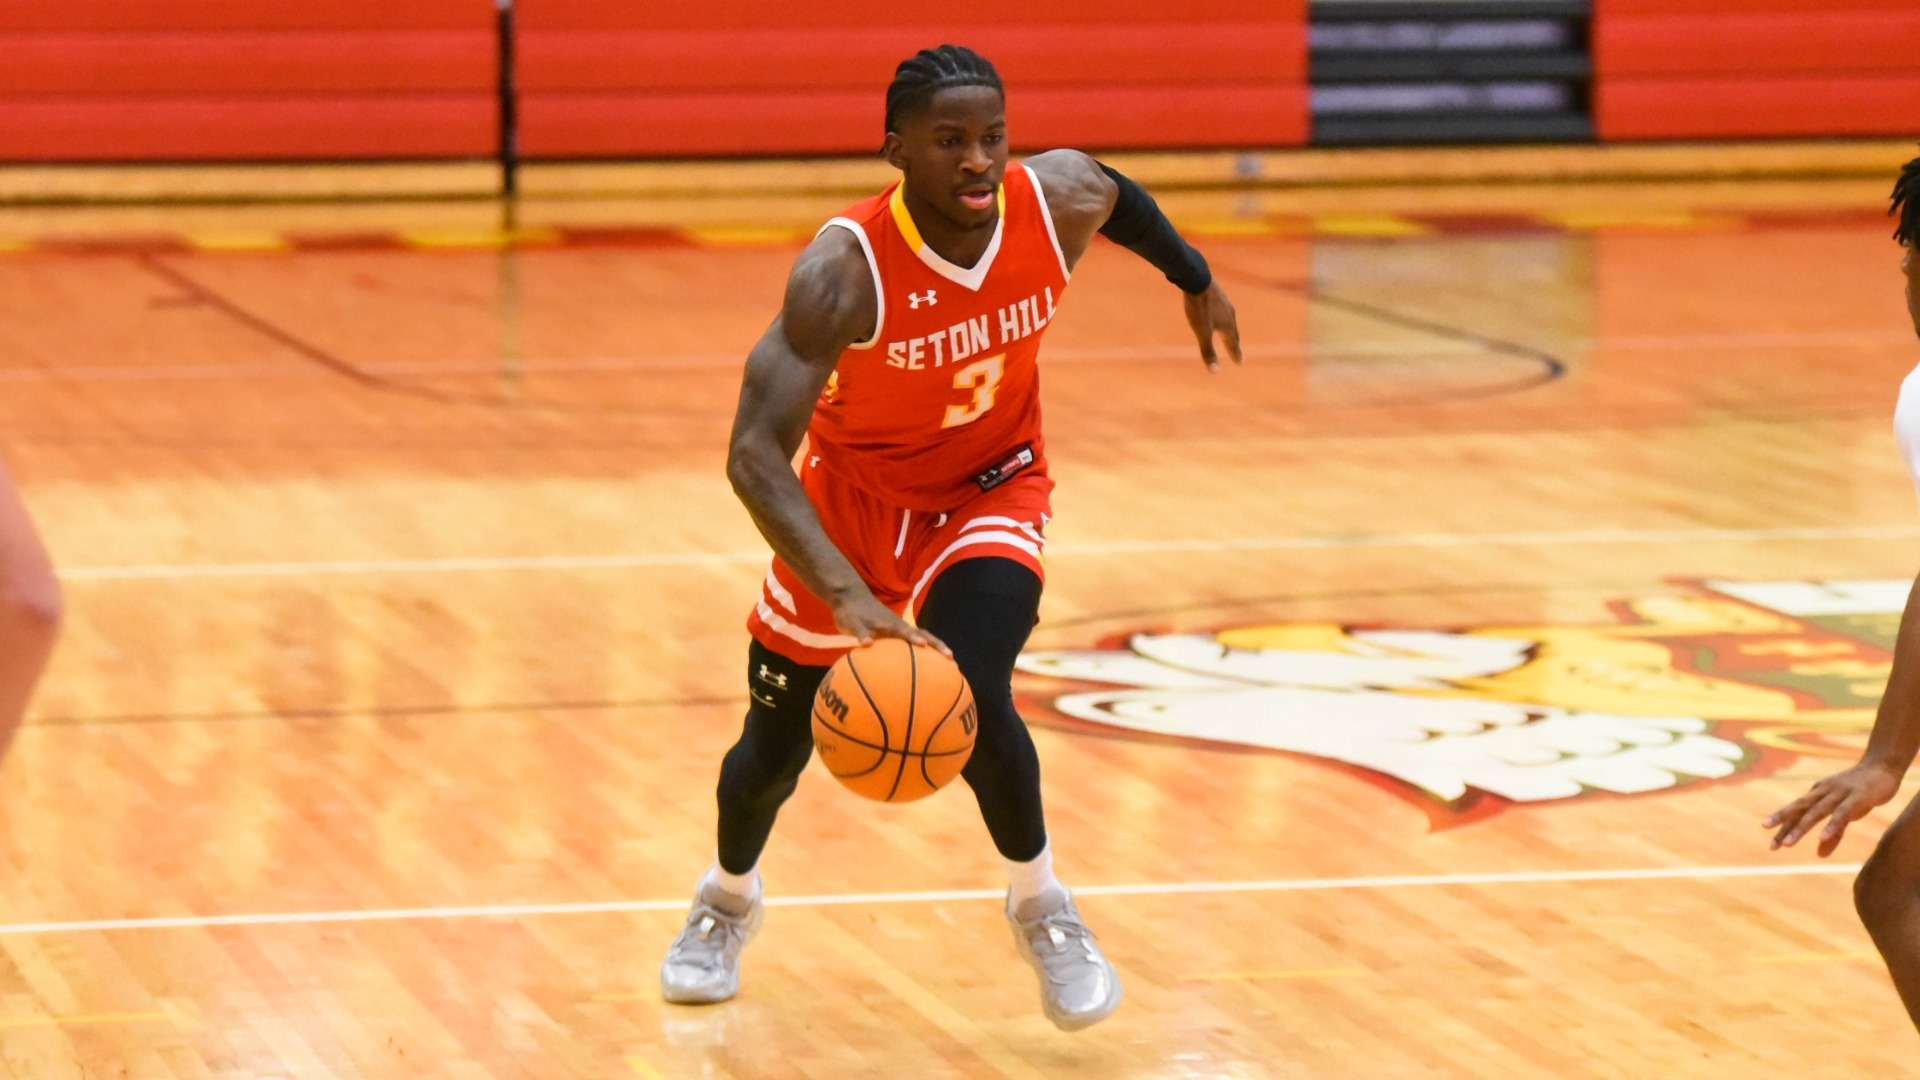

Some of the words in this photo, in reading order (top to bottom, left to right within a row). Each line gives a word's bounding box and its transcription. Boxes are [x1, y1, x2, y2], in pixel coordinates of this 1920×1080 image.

[886, 314, 990, 370] SETON
[998, 286, 1057, 345] HILL
[940, 352, 1007, 429] 3
